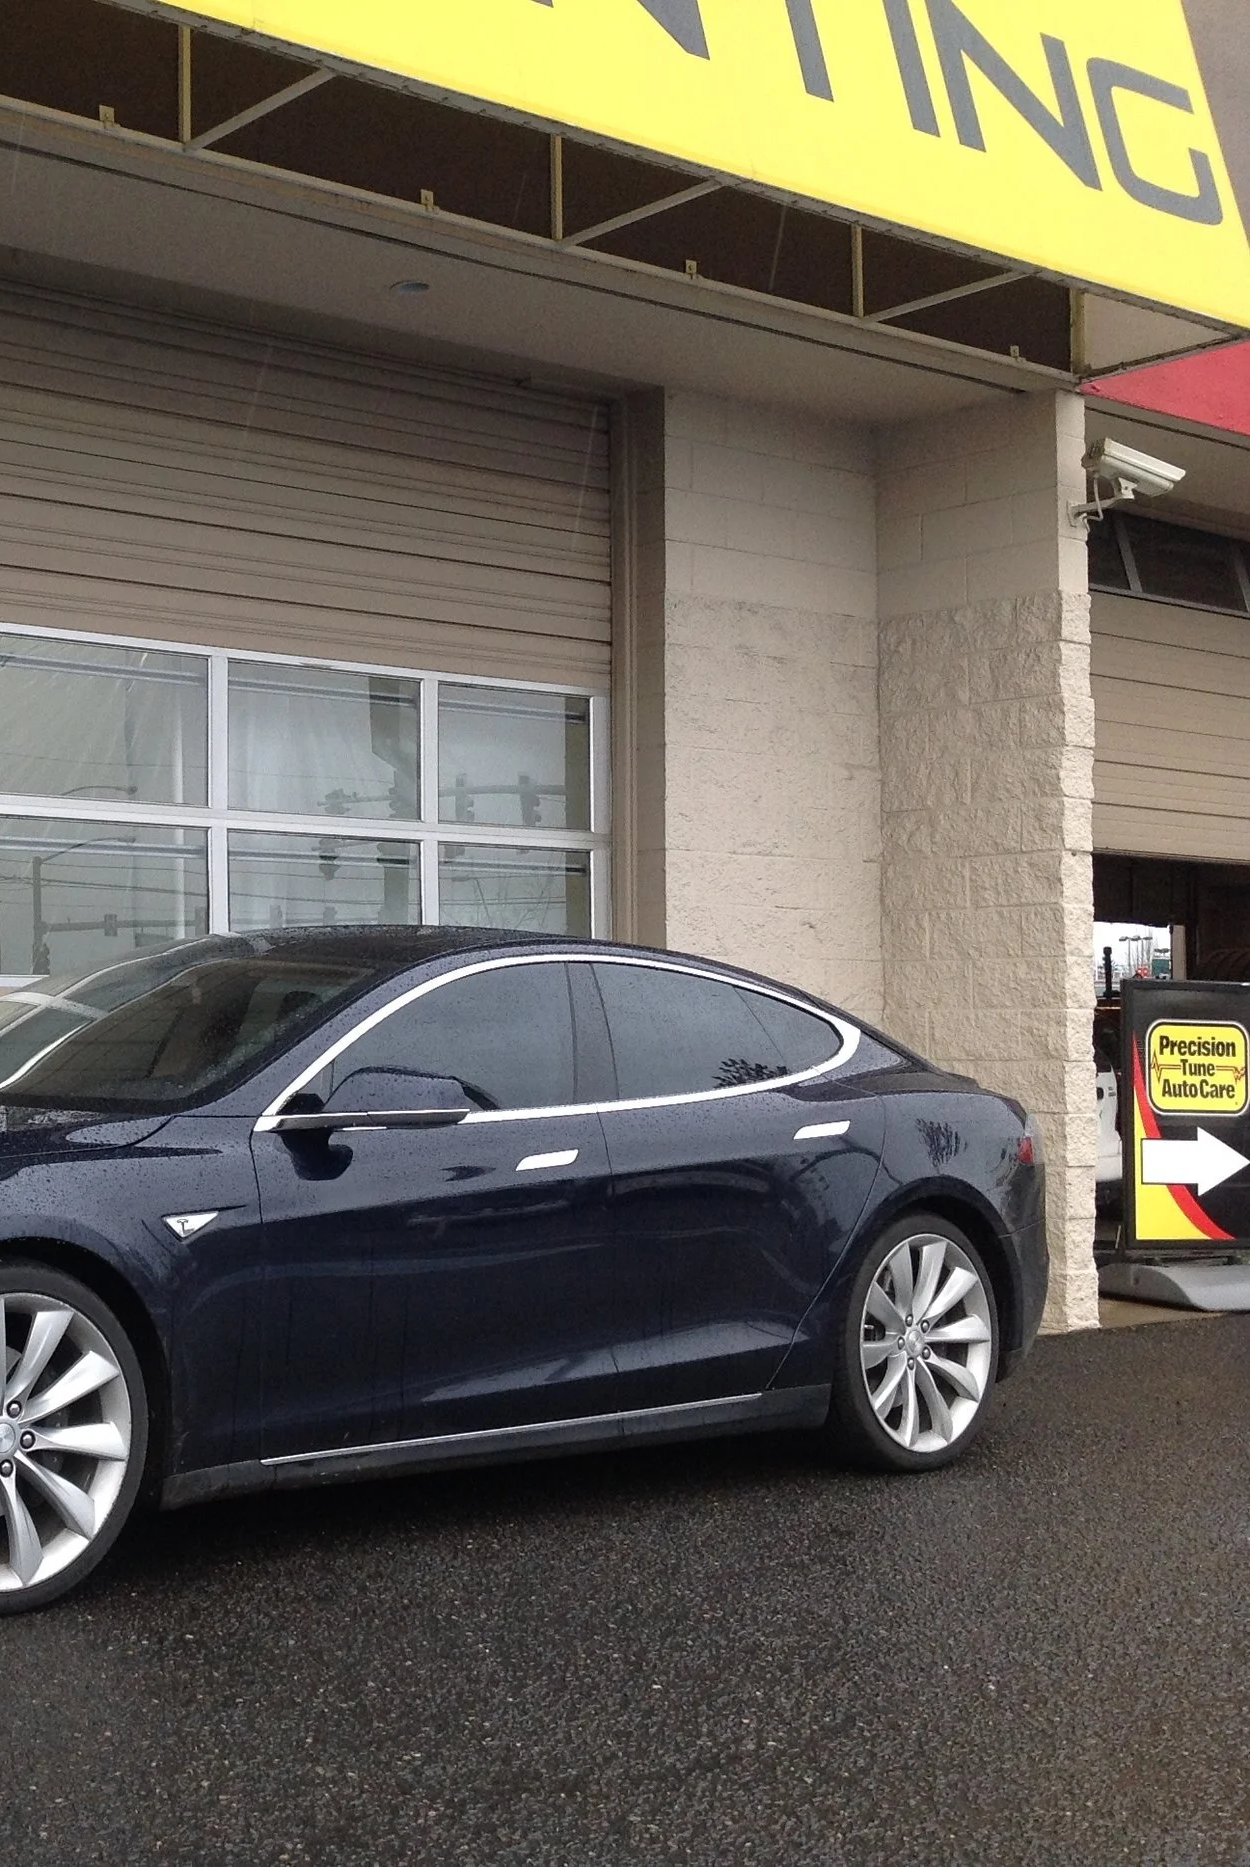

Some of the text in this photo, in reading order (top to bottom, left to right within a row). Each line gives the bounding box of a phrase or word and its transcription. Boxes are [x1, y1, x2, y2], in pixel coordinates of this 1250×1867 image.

[531, 0, 1222, 226] ING
[1159, 1035, 1236, 1057] Precision
[1180, 1058, 1216, 1077] Tune
